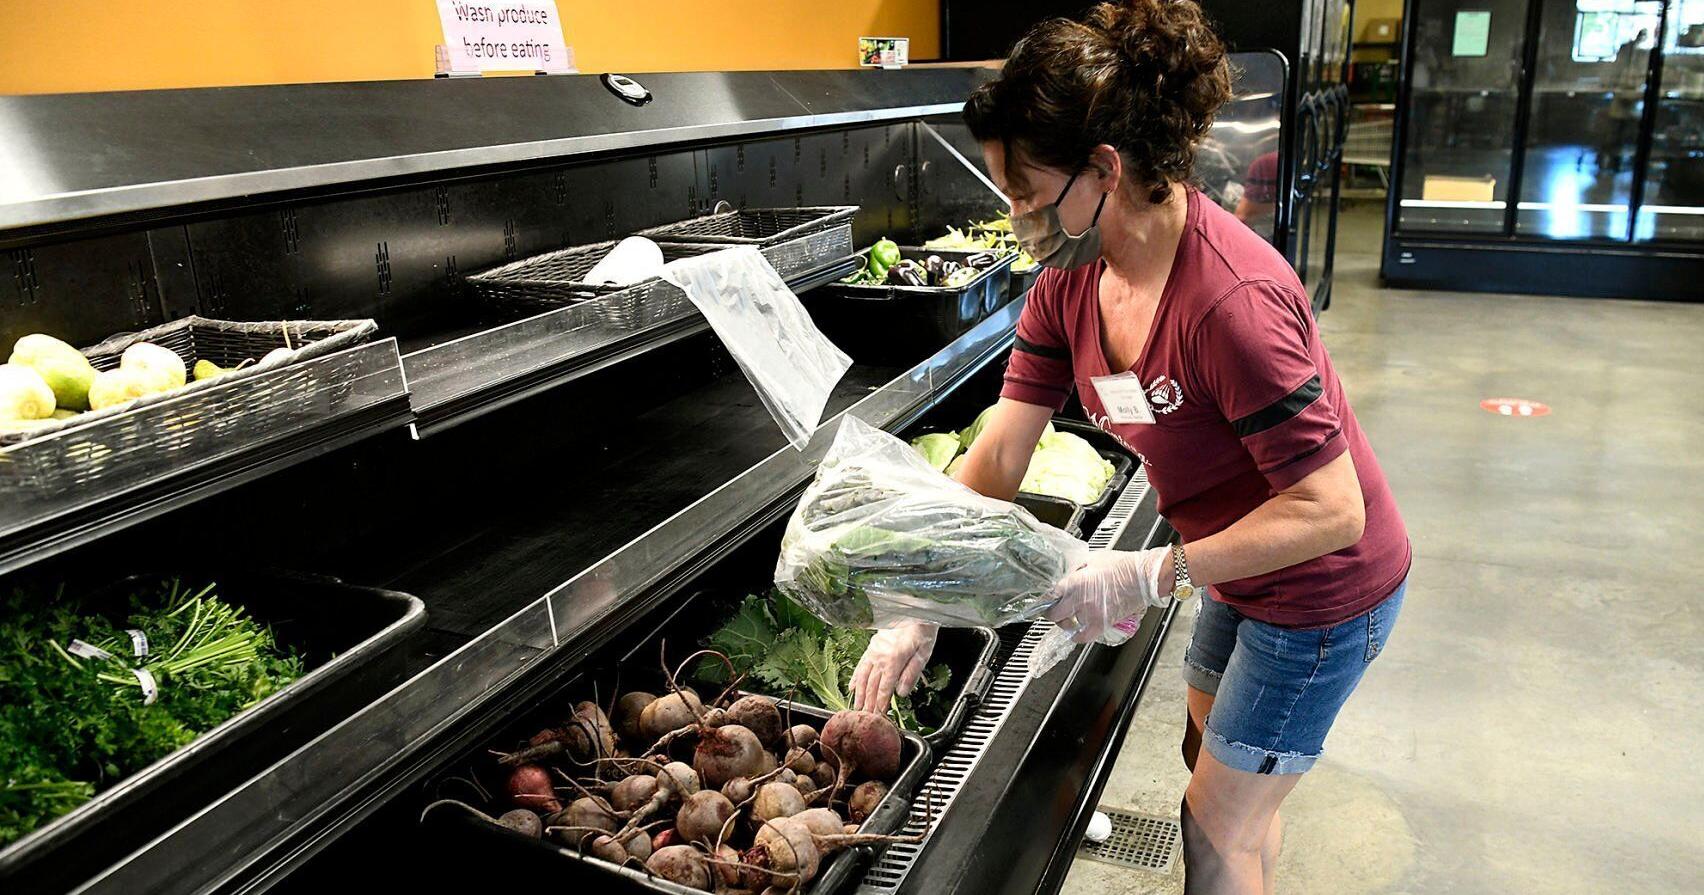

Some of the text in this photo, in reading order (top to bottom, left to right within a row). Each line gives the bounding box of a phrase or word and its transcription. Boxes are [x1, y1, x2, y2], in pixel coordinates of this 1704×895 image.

[498, 4, 548, 27] produce
[463, 36, 551, 62] before eating
